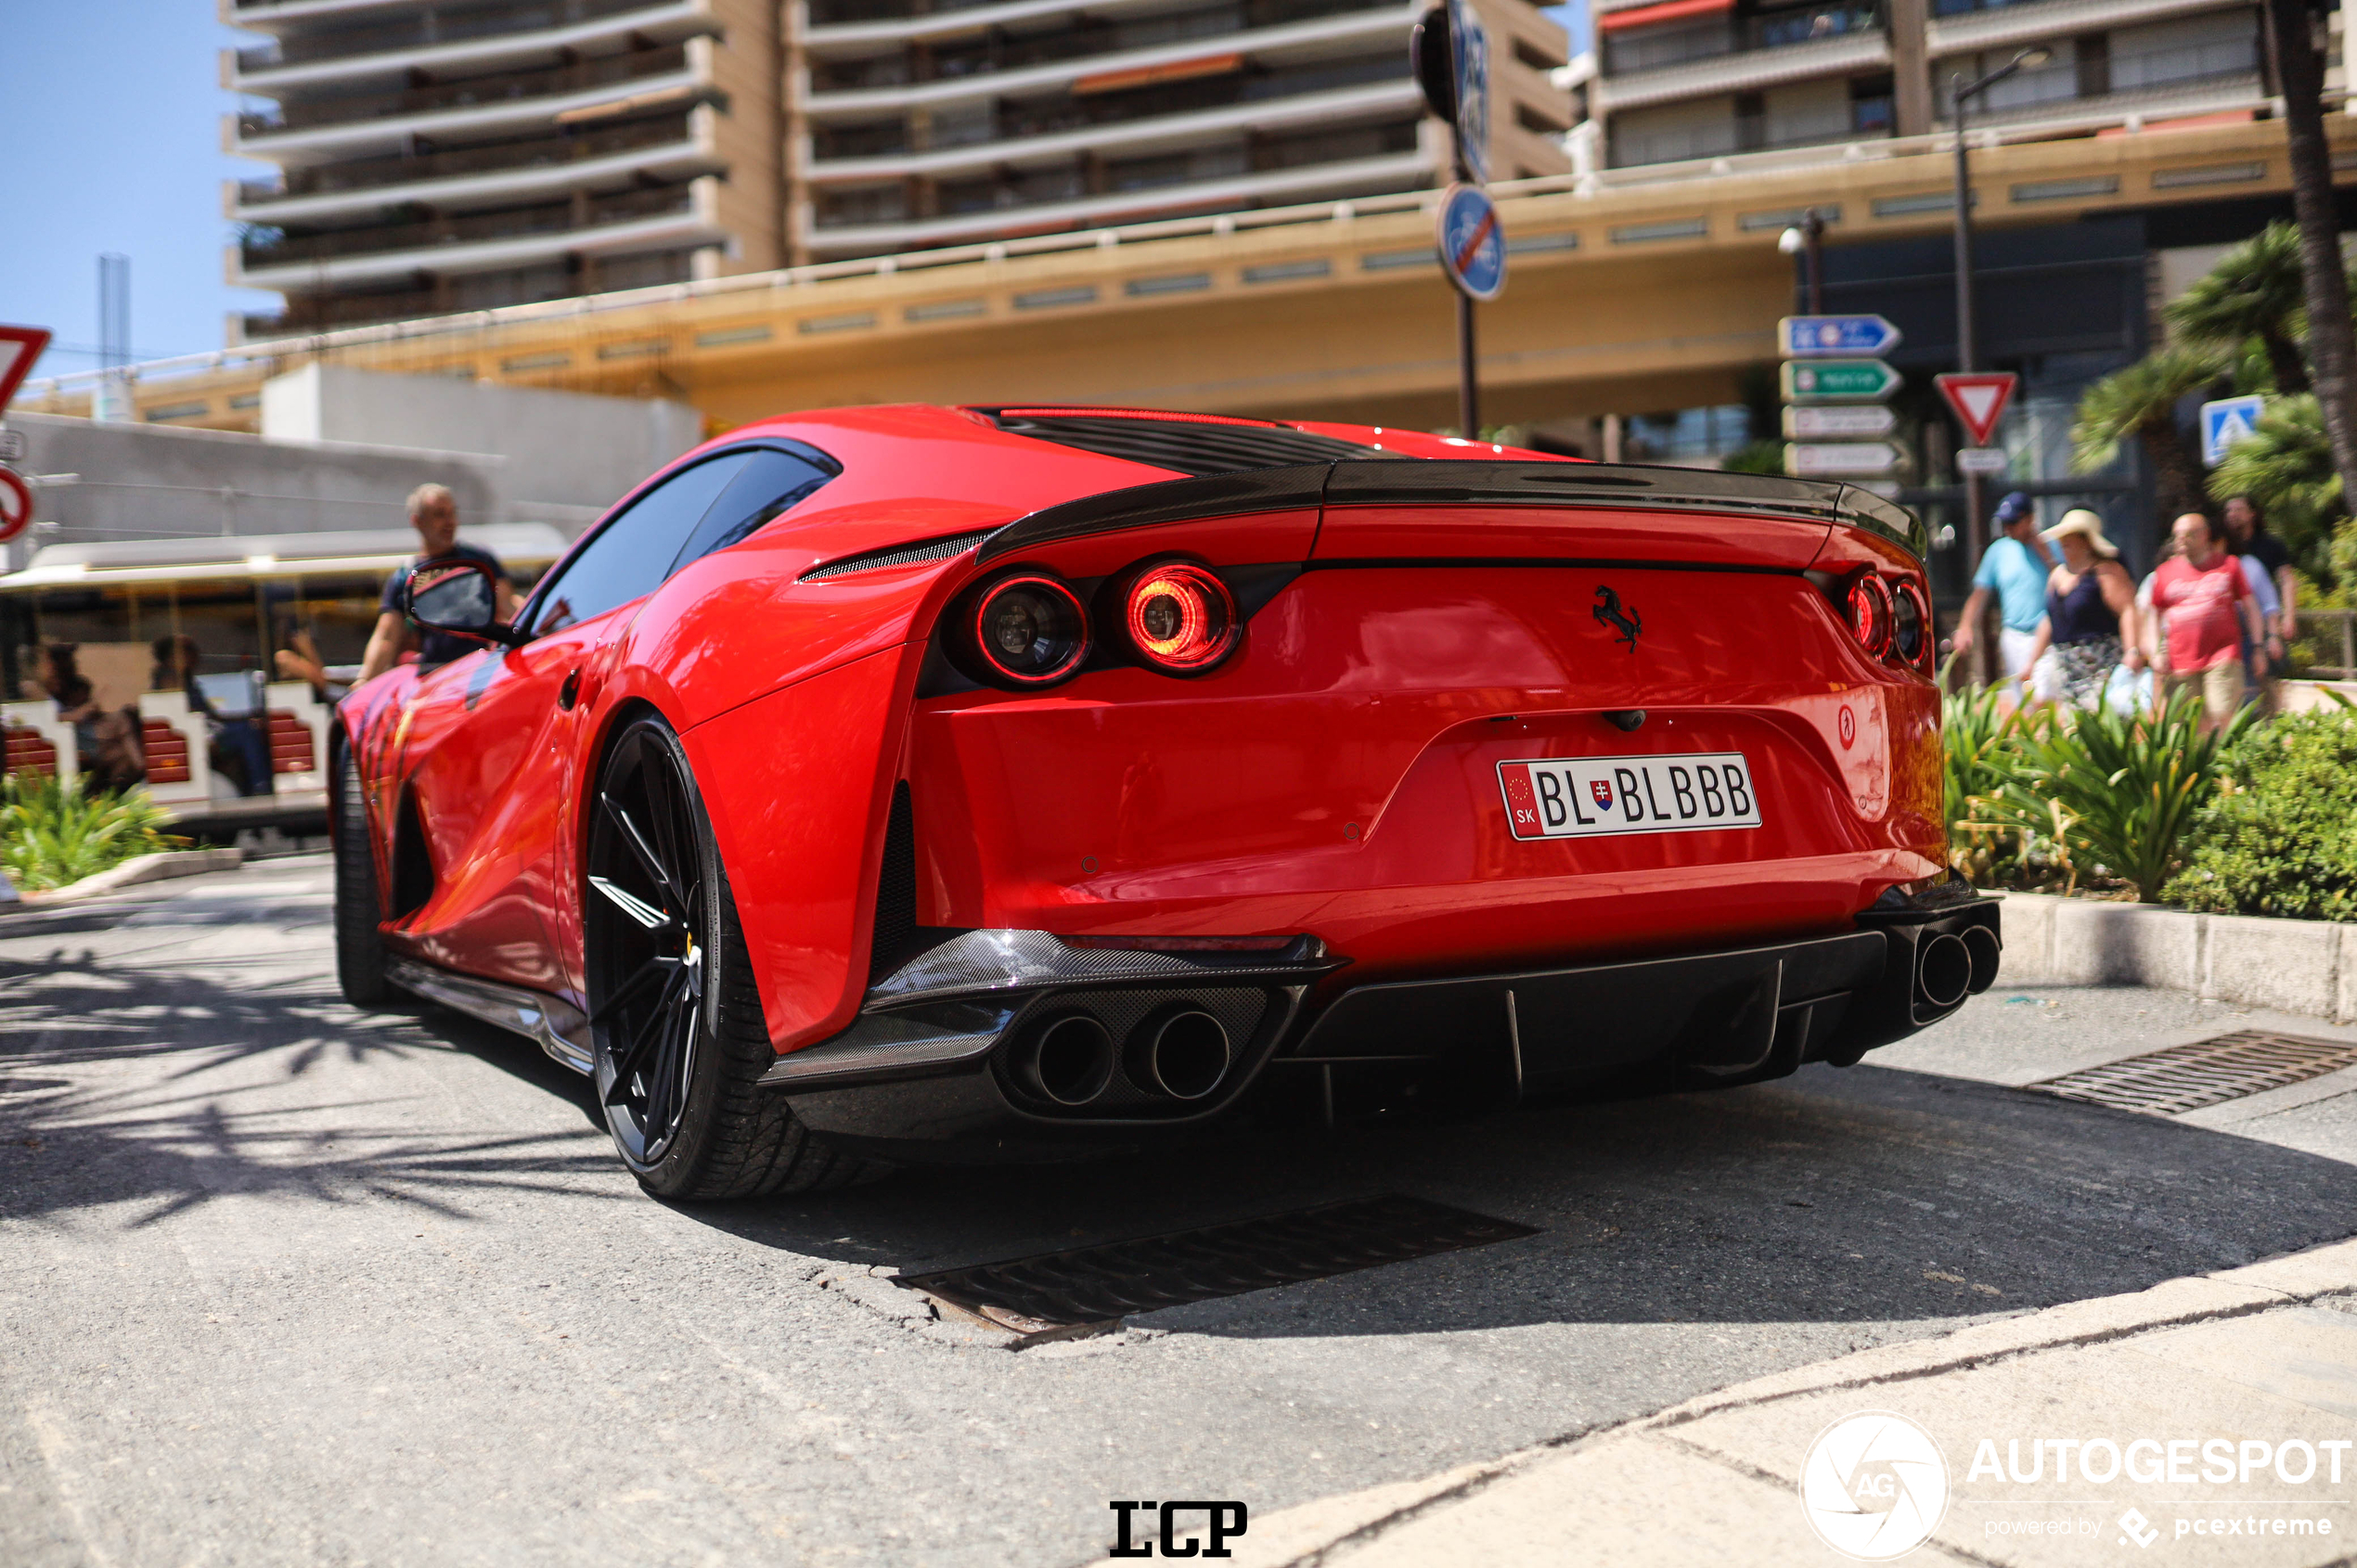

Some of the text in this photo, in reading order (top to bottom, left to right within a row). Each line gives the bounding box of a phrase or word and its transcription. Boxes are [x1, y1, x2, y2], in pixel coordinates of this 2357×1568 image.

[1537, 764, 1750, 827] BL BLBBB
[1516, 809, 1536, 823] SK
